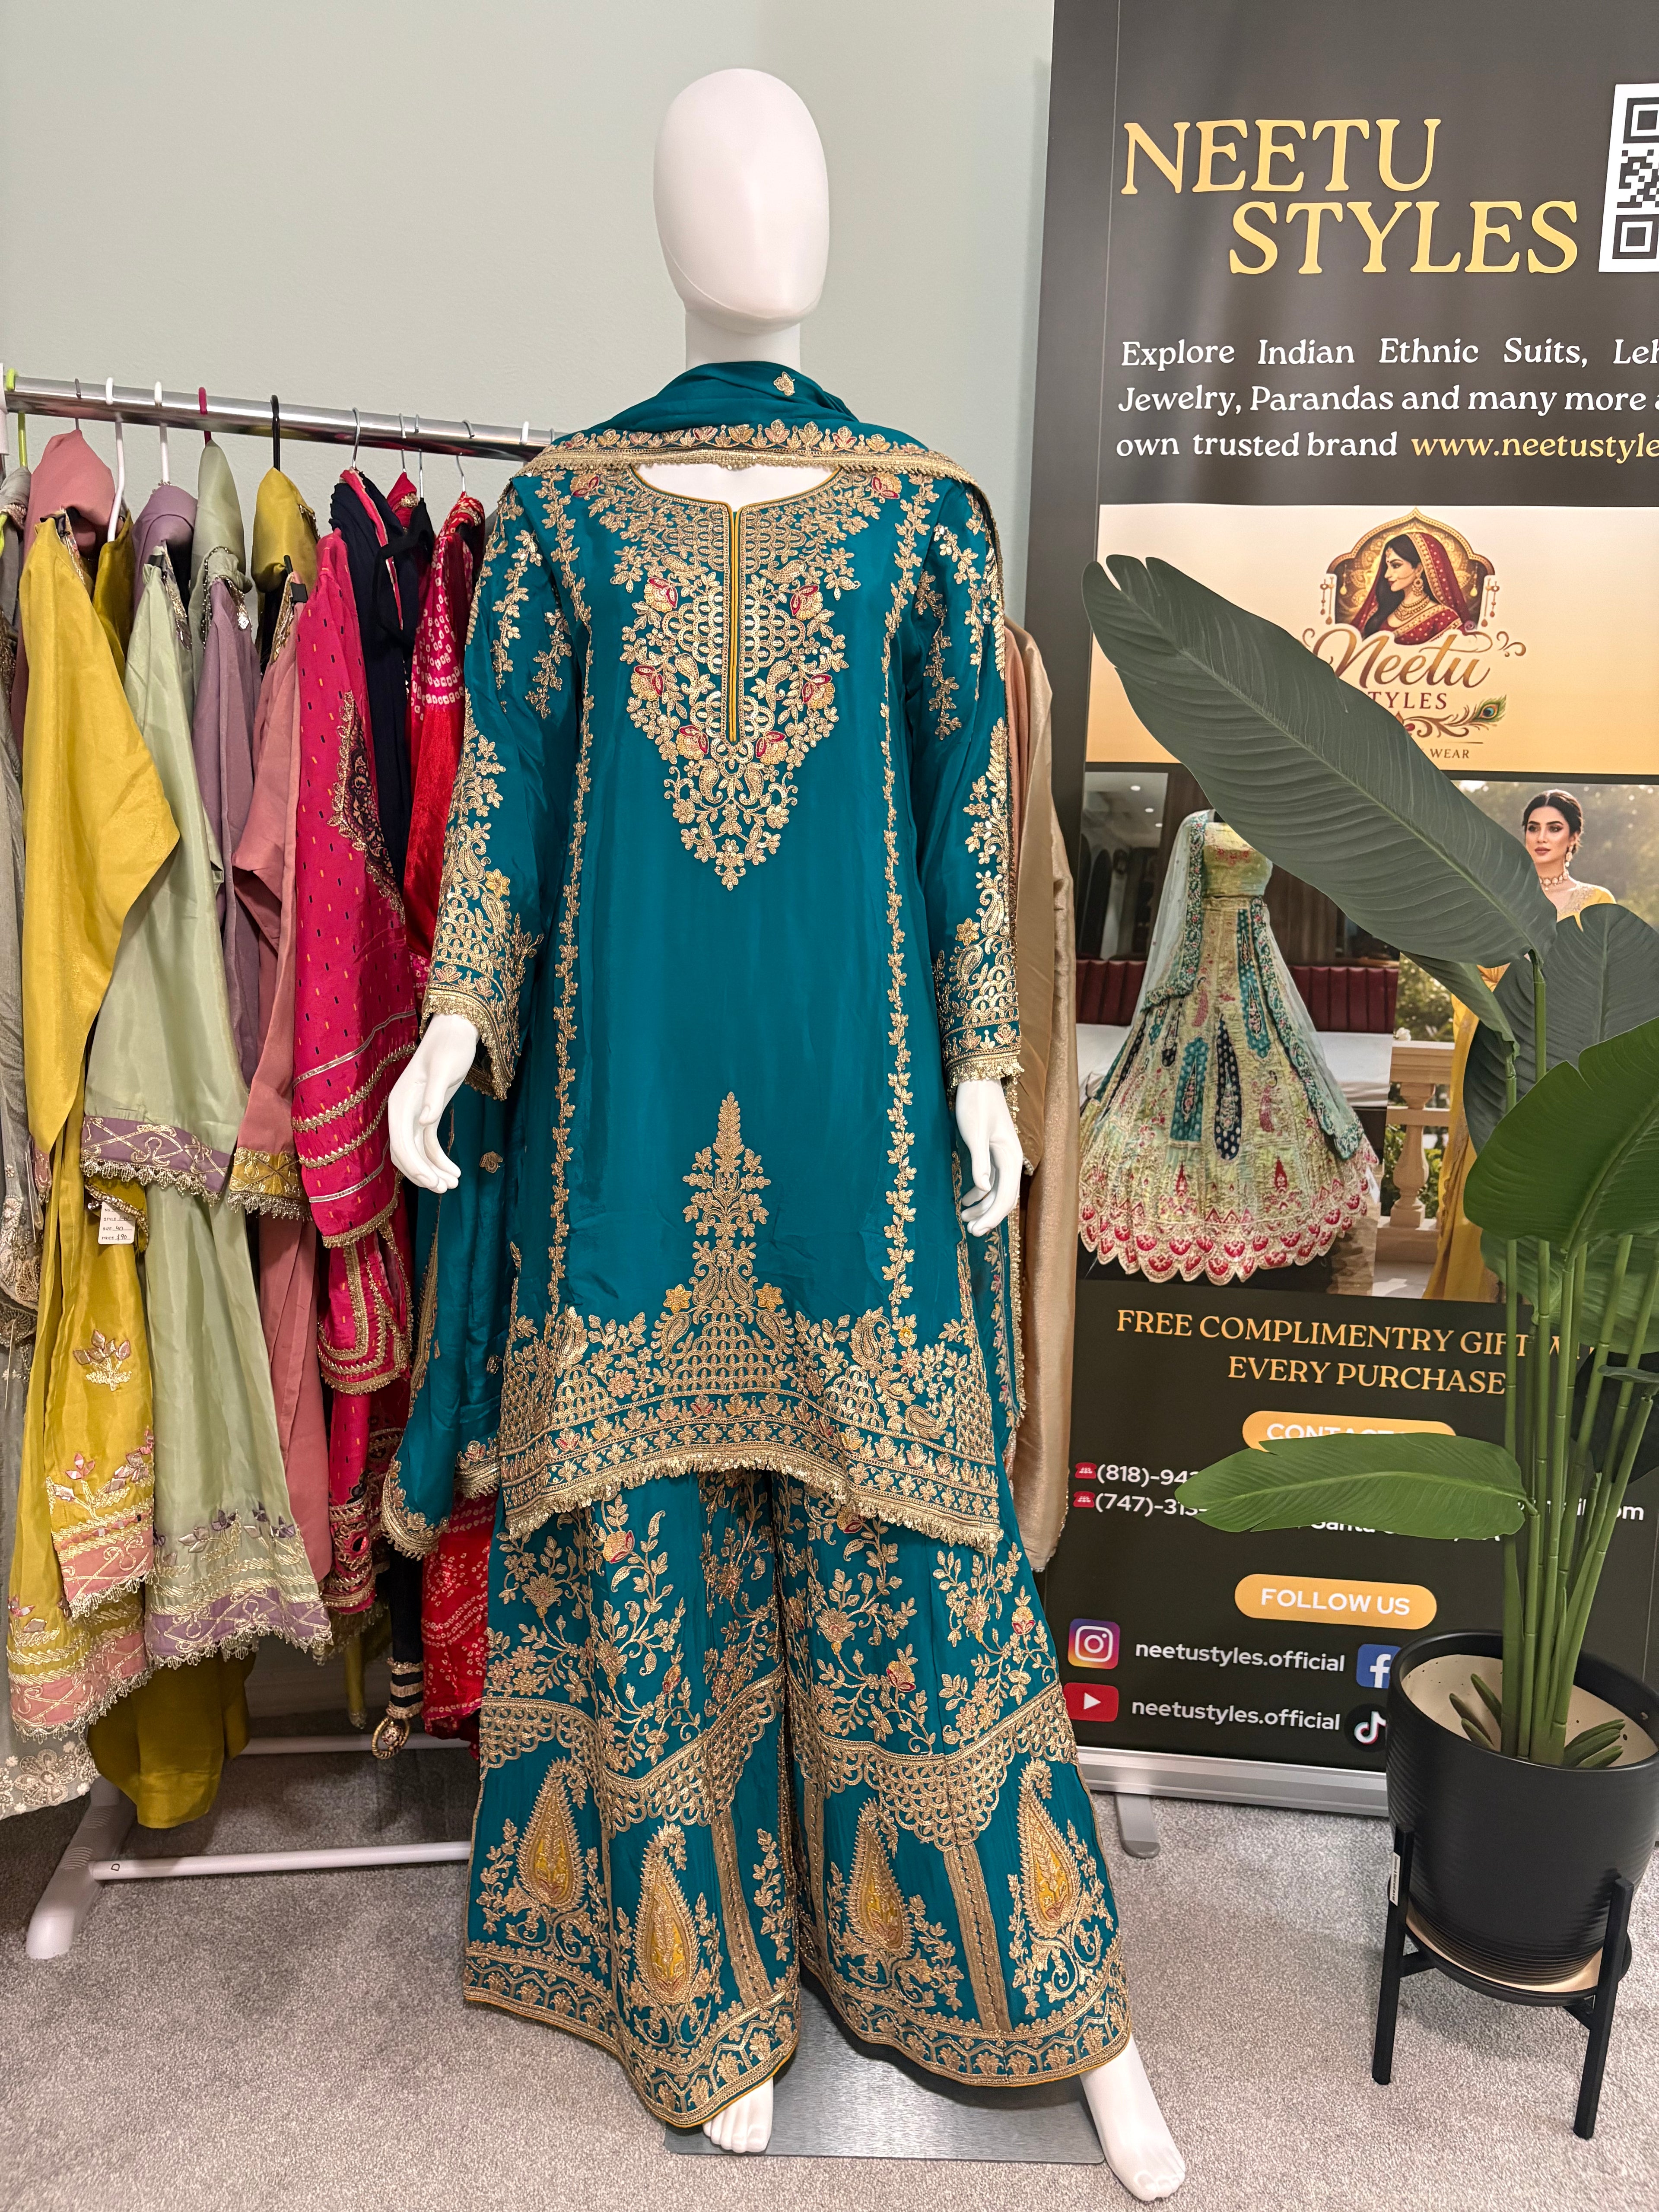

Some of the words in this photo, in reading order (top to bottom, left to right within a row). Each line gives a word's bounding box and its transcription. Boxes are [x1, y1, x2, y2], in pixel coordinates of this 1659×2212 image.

[1121, 119, 1441, 194] NEETU
[1229, 200, 1578, 274] STYLES
[1121, 339, 1235, 371] Explore
[1258, 339, 1355, 365] Indian
[1379, 338, 1479, 363] Ethnic
[1504, 338, 1587, 368] Suits,
[1118, 385, 1241, 416] Jewelry,
[1250, 385, 1393, 411] Parandas
[1402, 385, 1459, 410] and
[1468, 391, 1557, 416] many
[1564, 392, 1646, 411] more
[1116, 438, 1180, 457] own
[1192, 432, 1299, 457] trusted
[1307, 431, 1397, 456] brand
[1411, 432, 1659, 464] www.neetustyle
[1313, 629, 1493, 689] Neetu
[1367, 691, 1447, 710] TYLES
[1430, 748, 1469, 759] WEAR
[1117, 1309, 1192, 1336] FREE
[1200, 1316, 1454, 1351] COMPLIMENTRY
[1460, 1331, 1529, 1357] GIFT
[1228, 1356, 1331, 1383] EVERY
[1336, 1363, 1506, 1394] PURCHASE
[1097, 1464, 1199, 1487] (818)-94
[1261, 1588, 1371, 1612] FOLLOW
[1377, 1596, 1410, 1615] US
[1135, 1644, 1345, 1672] neetustyles.official
[1132, 1702, 1340, 1730] neetustyles.official
